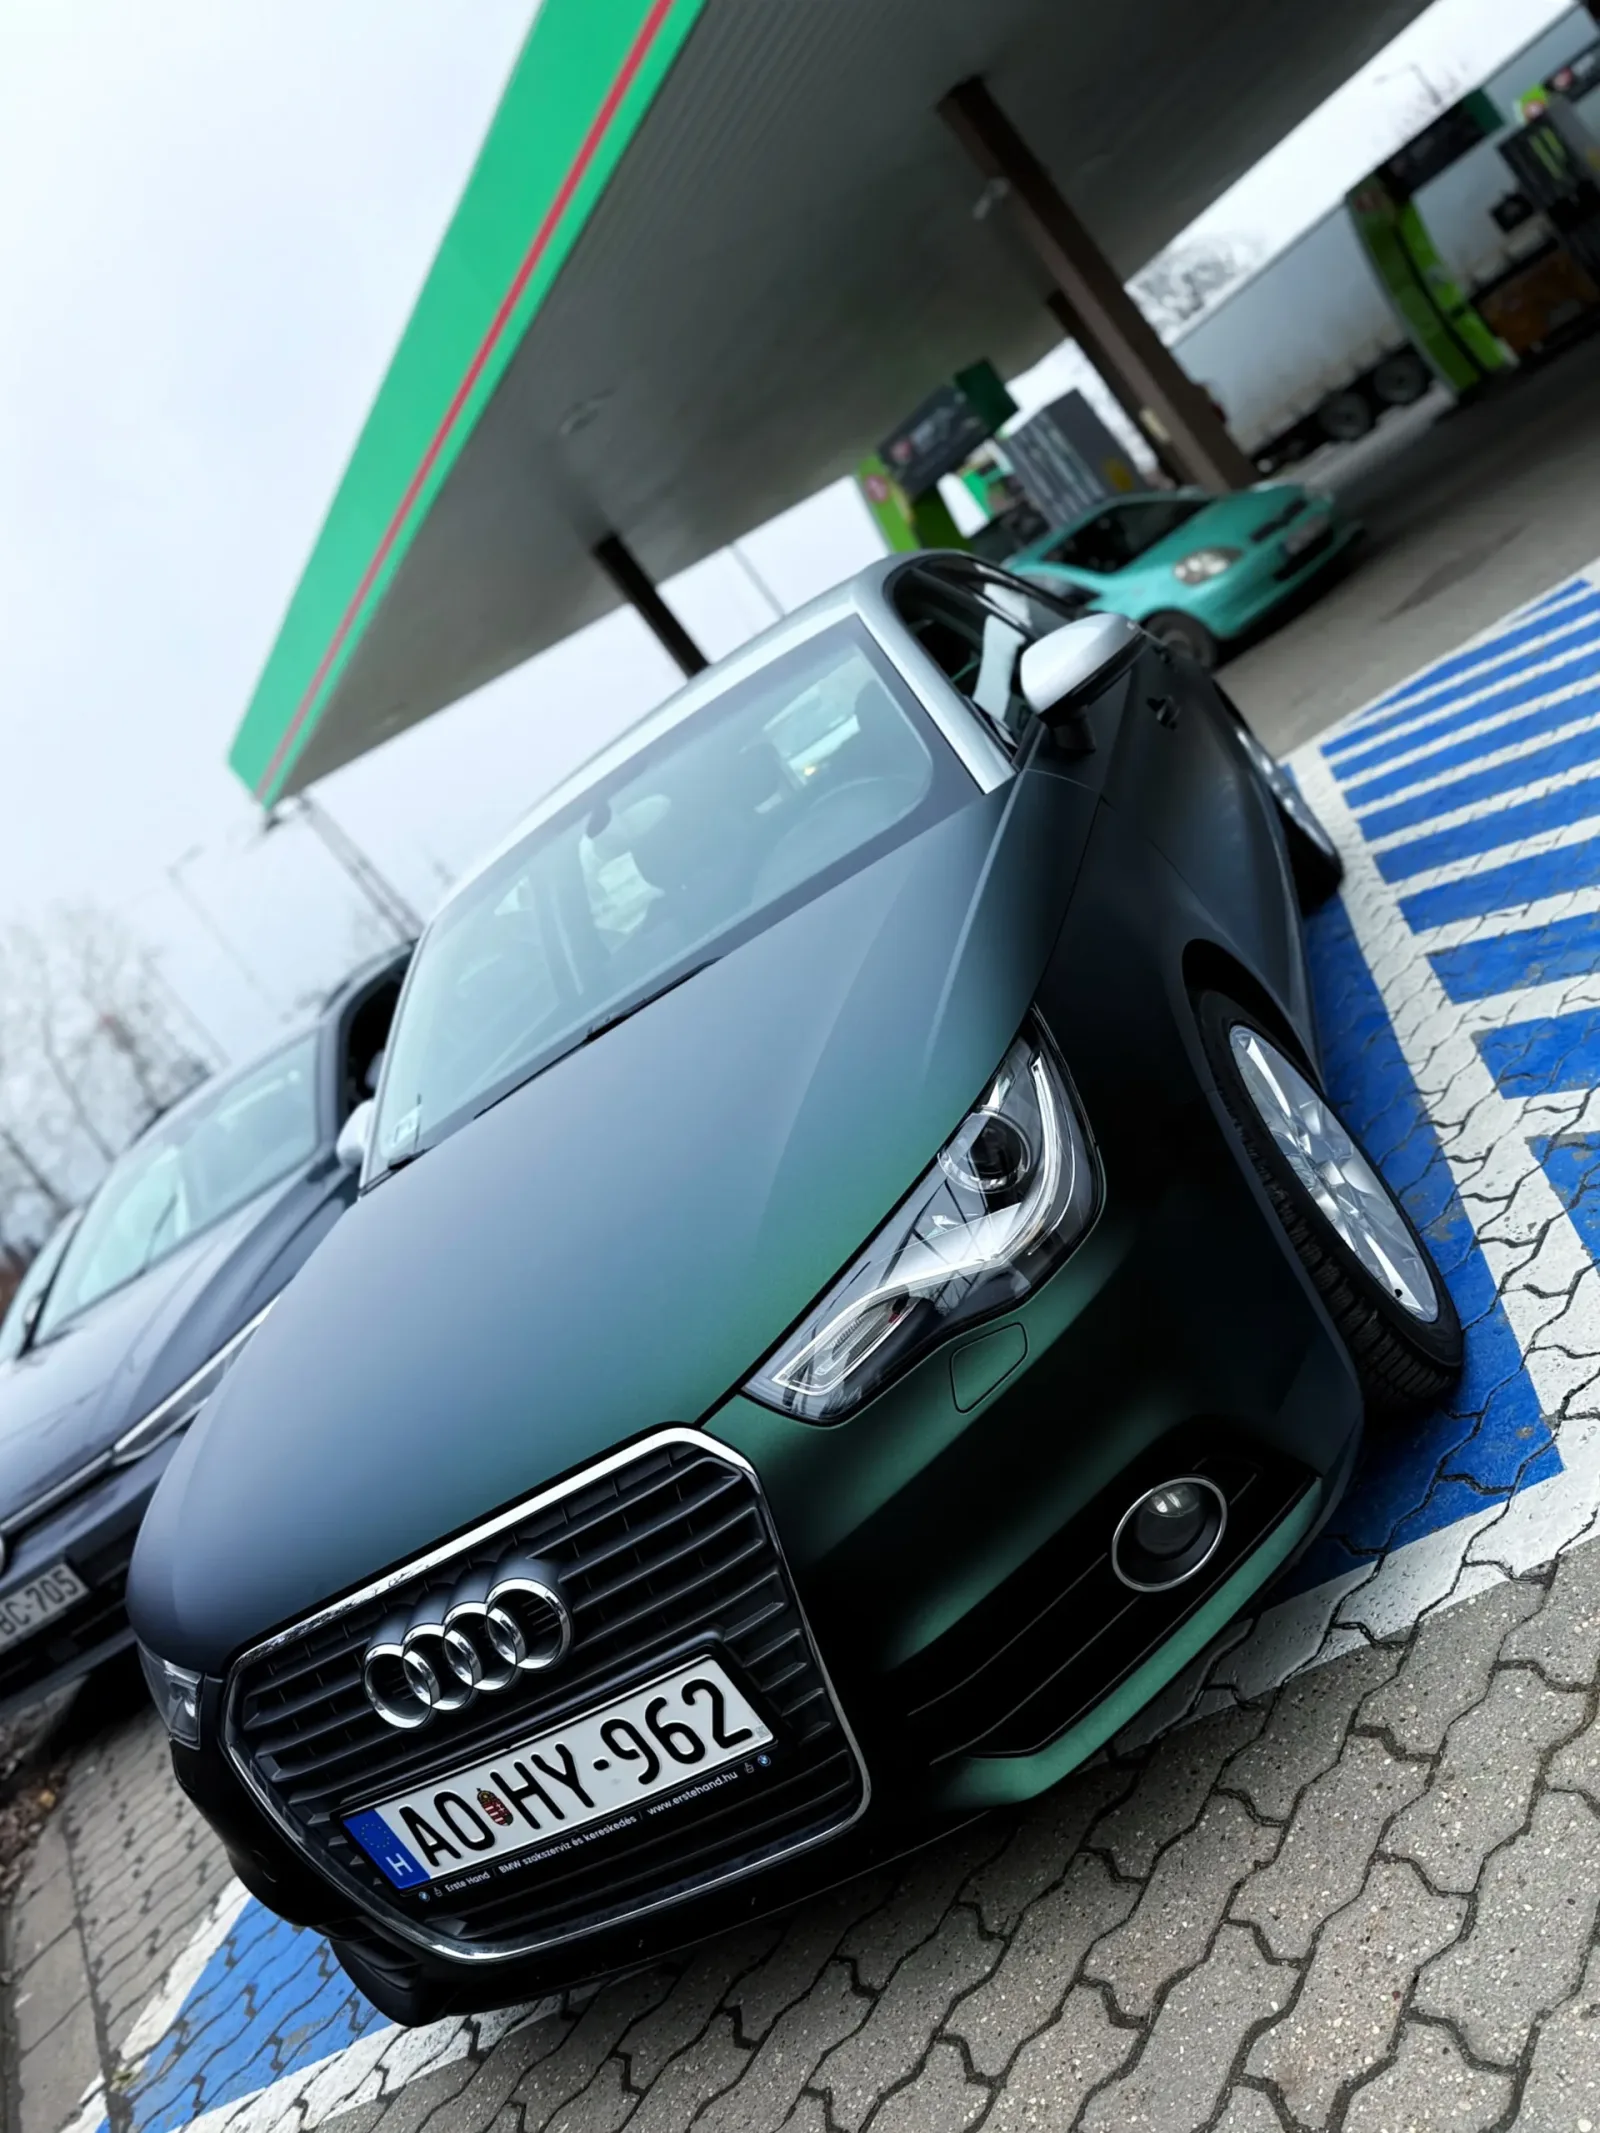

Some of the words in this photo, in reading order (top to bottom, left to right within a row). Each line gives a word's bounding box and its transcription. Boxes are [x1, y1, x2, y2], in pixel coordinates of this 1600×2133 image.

[385, 1853, 413, 1876] H
[445, 1878, 467, 1892] Erste
[466, 1871, 490, 1886] Hand
[498, 1859, 521, 1874] BMW
[522, 1842, 572, 1866] szakszerviz
[572, 1838, 584, 1847] és
[582, 1815, 637, 1842] kereskedés
[647, 1771, 738, 1815] www.erstehand.hu
